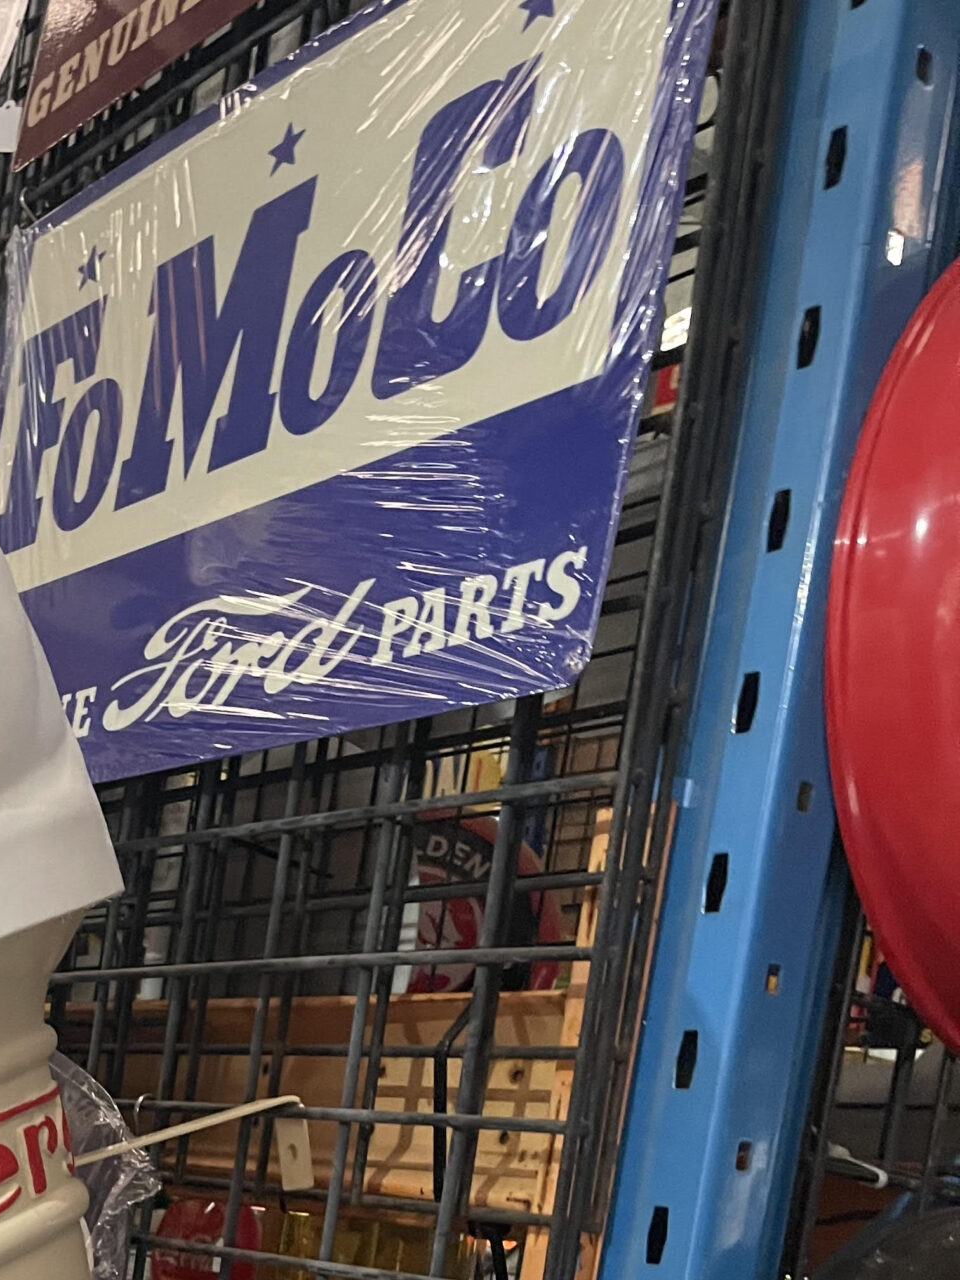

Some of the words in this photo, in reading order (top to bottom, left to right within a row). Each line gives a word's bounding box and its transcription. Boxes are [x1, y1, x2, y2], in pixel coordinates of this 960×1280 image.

[27, 0, 204, 128] GENUIN
[102, 577, 376, 732] Ford
[371, 545, 588, 666] PARTS
[413, 834, 490, 880] DEN
